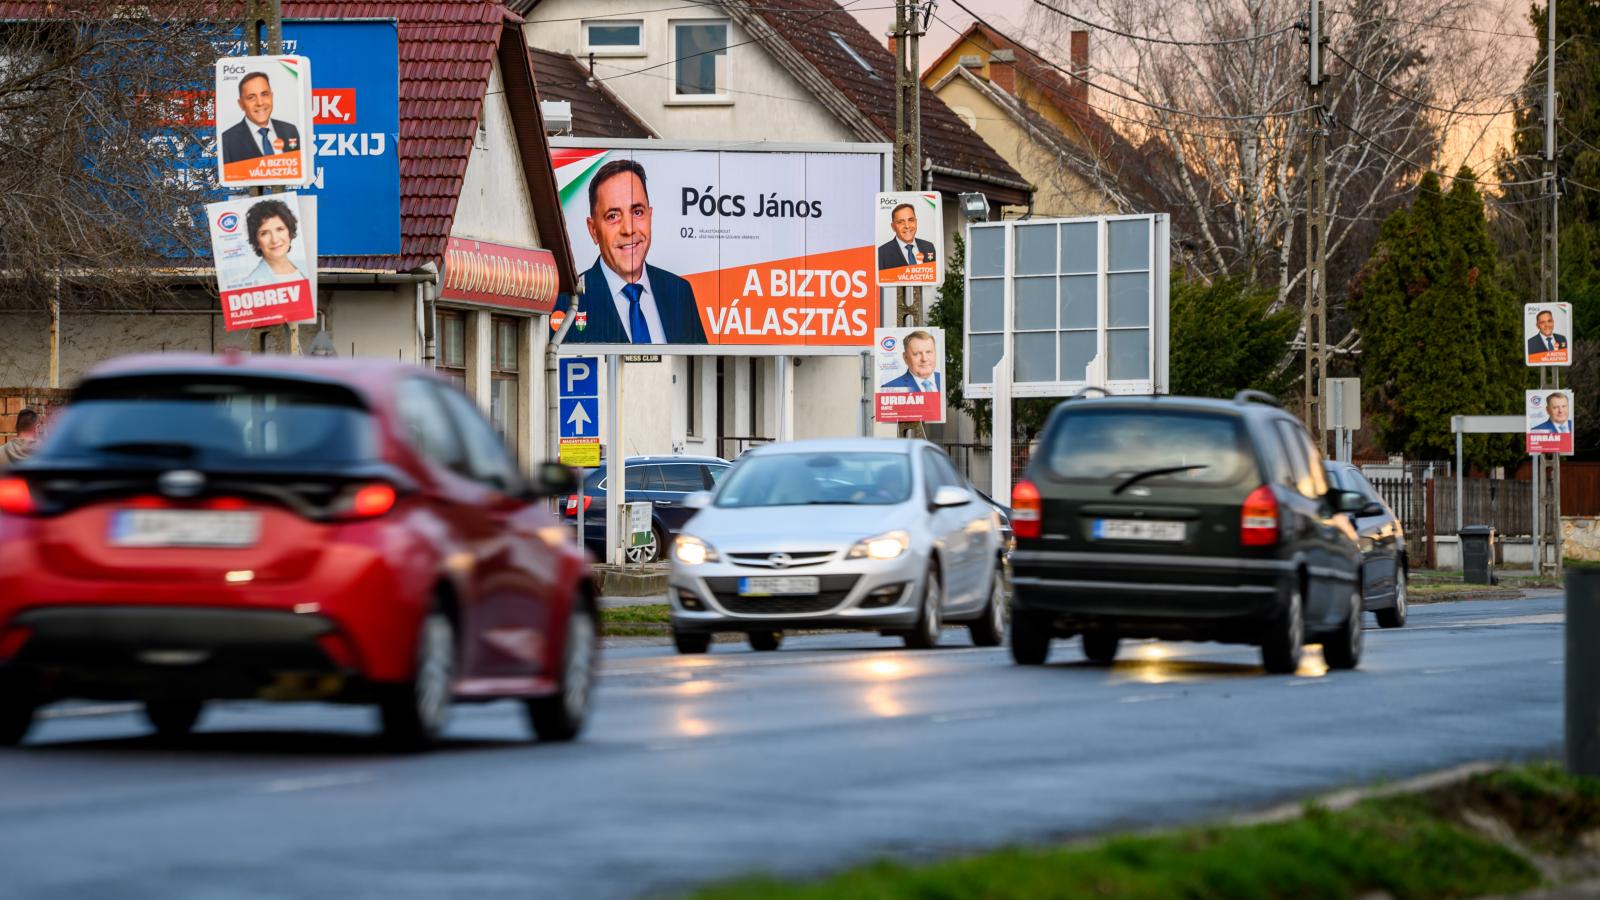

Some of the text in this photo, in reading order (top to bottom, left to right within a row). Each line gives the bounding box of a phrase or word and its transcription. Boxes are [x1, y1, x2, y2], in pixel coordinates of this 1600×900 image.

[223, 65, 246, 74] Pócs
[259, 158, 299, 167] A BIZTOS
[248, 167, 299, 178] VÁLASZTÁS
[681, 186, 822, 219] Pócs János
[880, 197, 898, 205] Pócs
[680, 227, 697, 239] 02.
[897, 273, 934, 281] VÁLASZTÁS
[743, 269, 868, 299] A BIZTOS
[227, 285, 301, 311] DOBREV
[230, 308, 254, 319] KLÁRA
[706, 300, 868, 337] VÁLASZTÁS
[567, 362, 590, 392] P
[880, 393, 925, 405] URBÁN
